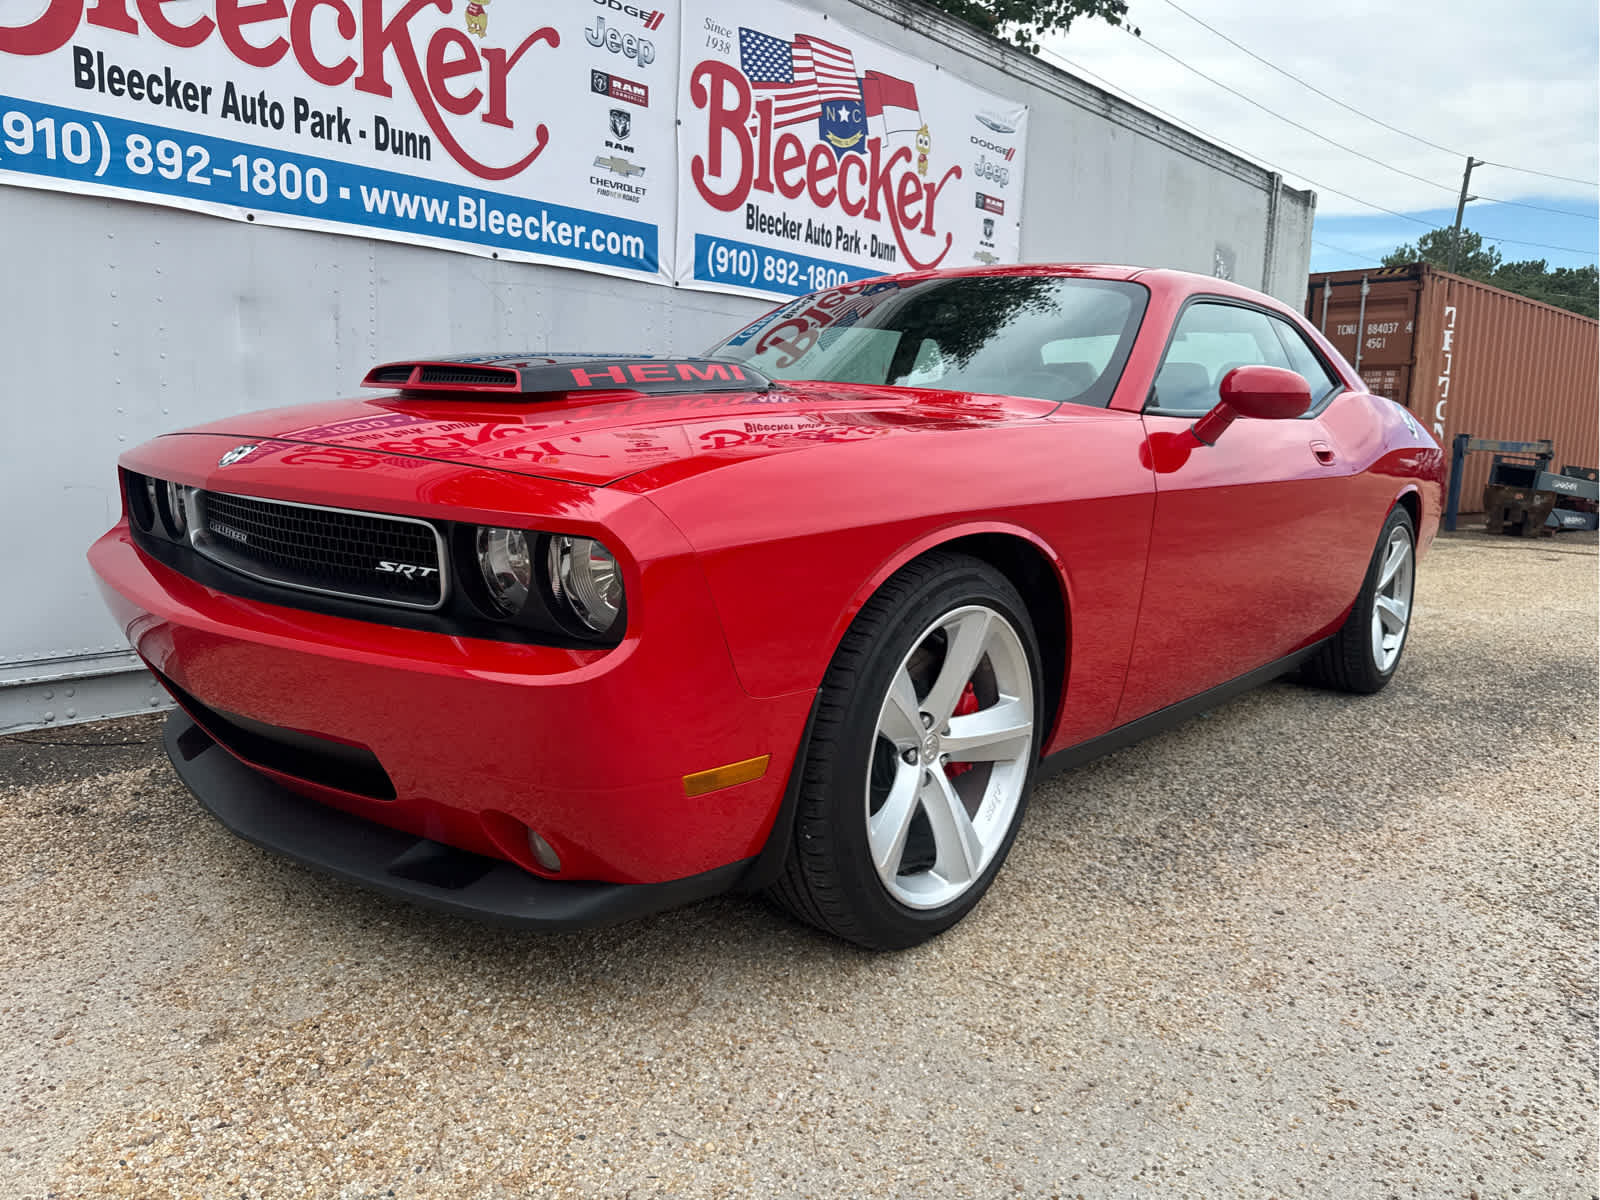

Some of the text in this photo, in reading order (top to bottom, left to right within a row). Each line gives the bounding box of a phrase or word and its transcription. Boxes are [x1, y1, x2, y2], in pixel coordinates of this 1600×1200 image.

[704, 17, 732, 39] Since
[585, 16, 655, 68] Jeep
[706, 35, 731, 55] 1938
[0, 0, 560, 181] ecker
[612, 80, 645, 96] RAM
[73, 45, 432, 161] Bleecker Auto Park Dunn
[605, 140, 634, 153] RAM
[690, 60, 962, 271] Bleecker
[975, 155, 1009, 188] Jeep
[0, 110, 645, 259] 910) 892-1800 www.Bleecker.com
[590, 176, 647, 196] CHEVROLET
[746, 203, 896, 262] Bleecker Auto Park Dunn
[707, 241, 849, 290] (910) 892-1800
[1337, 324, 1357, 336] TCNU
[1366, 338, 1386, 349] 45G1
[570, 364, 746, 387] HEMI
[375, 561, 438, 580] SRT
